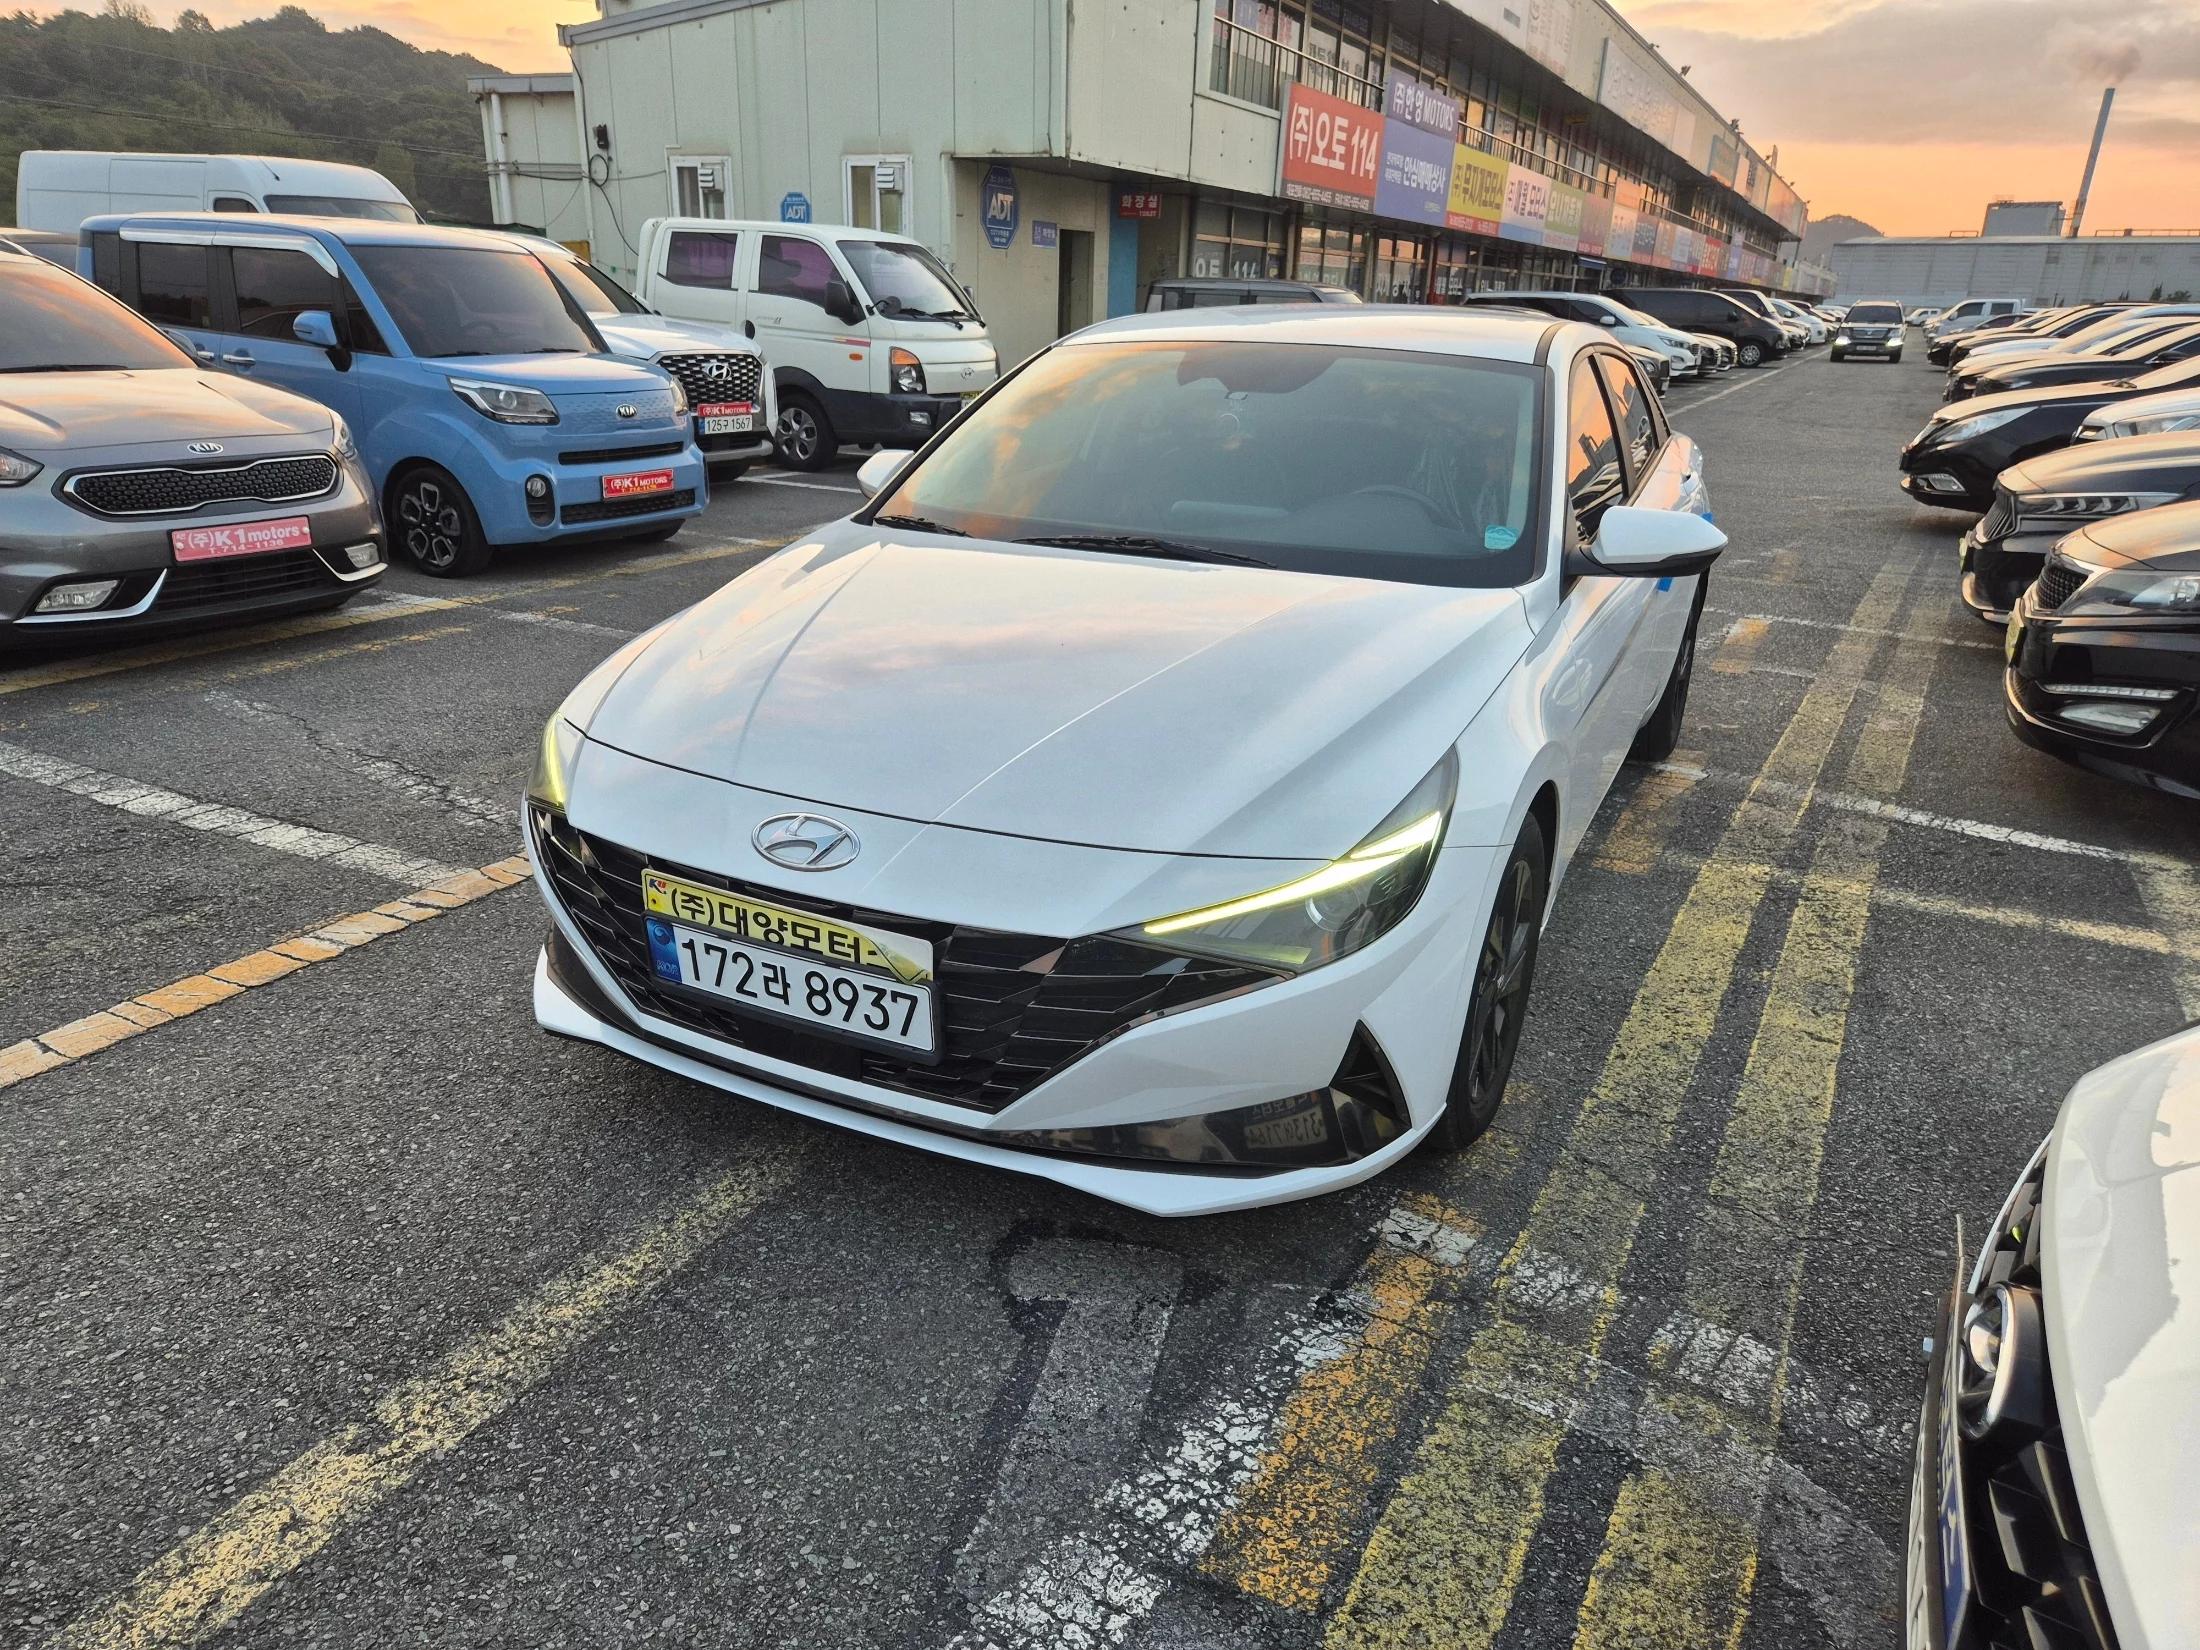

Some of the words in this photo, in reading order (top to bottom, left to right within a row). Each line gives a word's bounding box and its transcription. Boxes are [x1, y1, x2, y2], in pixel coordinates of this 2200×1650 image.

[1350, 125, 1379, 180] 114
[988, 192, 1014, 221] ADT
[1121, 194, 1158, 209] 화장실
[786, 205, 805, 220] ADT
[618, 406, 636, 417] KIA
[731, 417, 751, 430] 1567
[193, 442, 220, 452] KIA
[671, 886, 888, 969] (주)대양모터
[681, 936, 791, 1006] 172라
[804, 970, 919, 1037] 8937
